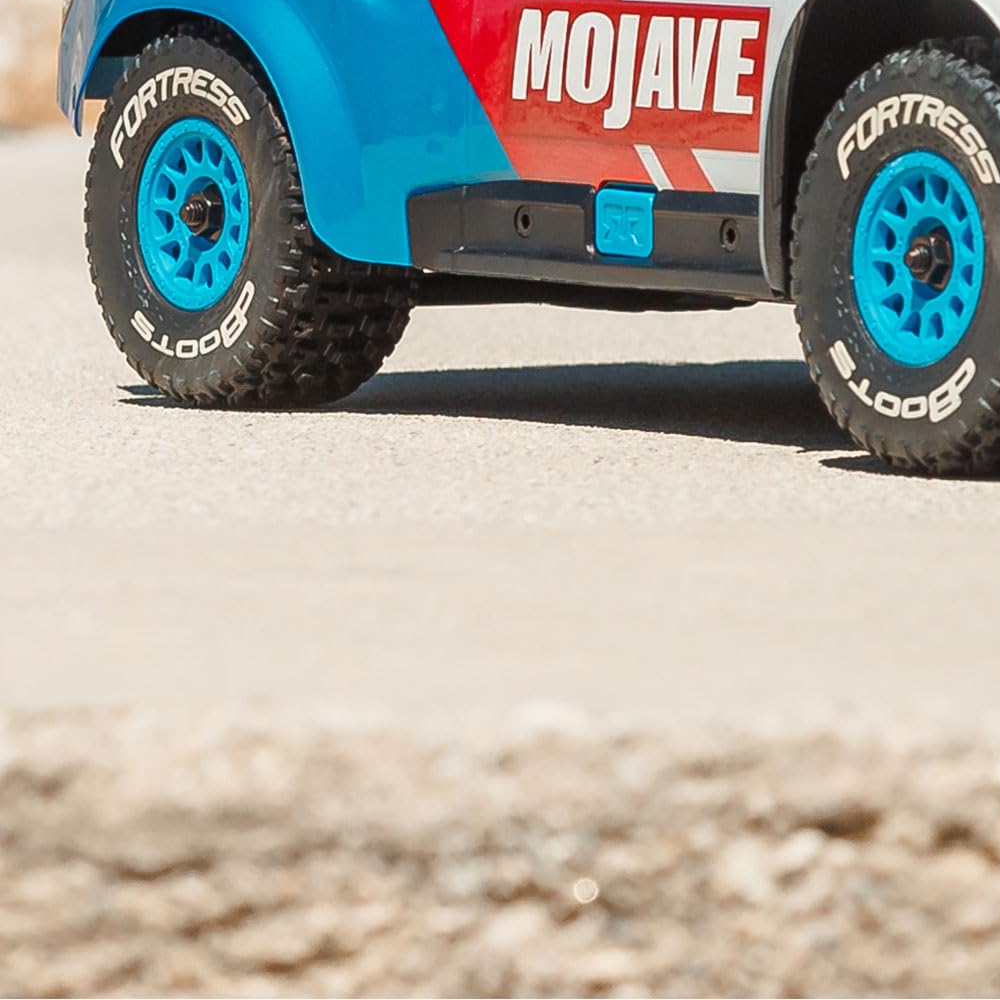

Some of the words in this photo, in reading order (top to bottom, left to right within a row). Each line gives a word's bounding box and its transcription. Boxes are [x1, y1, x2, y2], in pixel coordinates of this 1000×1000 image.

[511, 7, 761, 129] MOJAVE
[110, 67, 250, 168] FORTRESS
[131, 280, 254, 358] BOOTS
[829, 340, 976, 422] BOOTS
